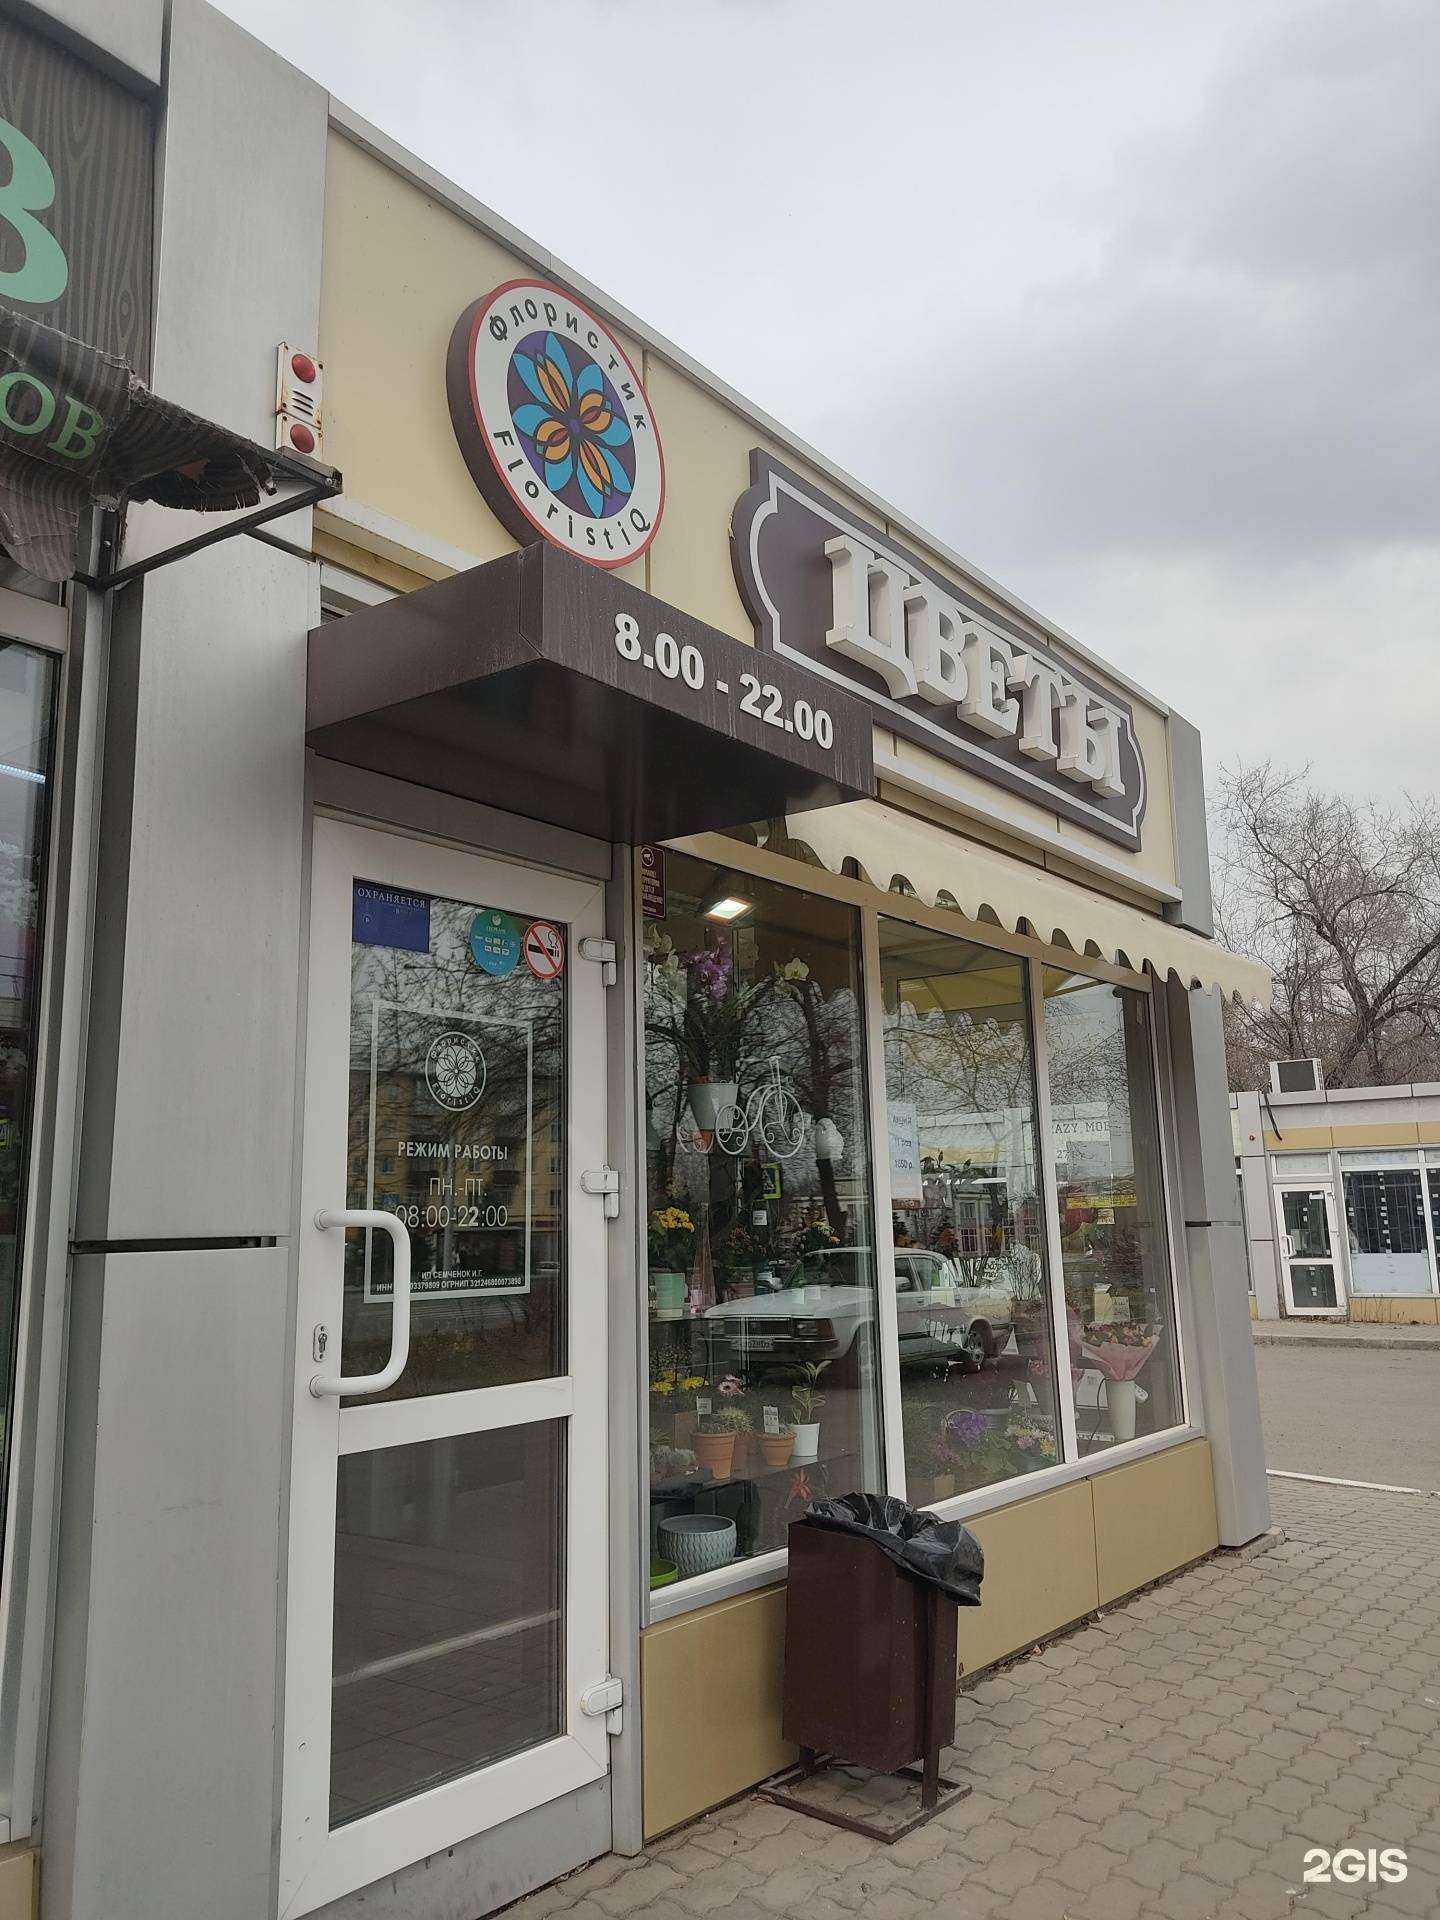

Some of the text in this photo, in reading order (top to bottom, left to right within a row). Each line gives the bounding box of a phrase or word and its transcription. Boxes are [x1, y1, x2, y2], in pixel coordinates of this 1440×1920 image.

[489, 298, 647, 430] Флористик
[493, 430, 651, 551] FloristiQ
[824, 534, 1126, 799] ЦВЕТЫ
[614, 613, 705, 690] 8.00
[739, 673, 834, 750] 22.00
[357, 887, 426, 909] ОХРАНЯЕТСЯ
[397, 1141, 508, 1161] РЕЖИМ РАБОТЫ
[395, 1204, 508, 1228] 08:00-22:00
[421, 1271, 432, 1279] ИП
[432, 1270, 471, 1279] СЕМЧЕНОК
[376, 1284, 393, 1292] ИНН
